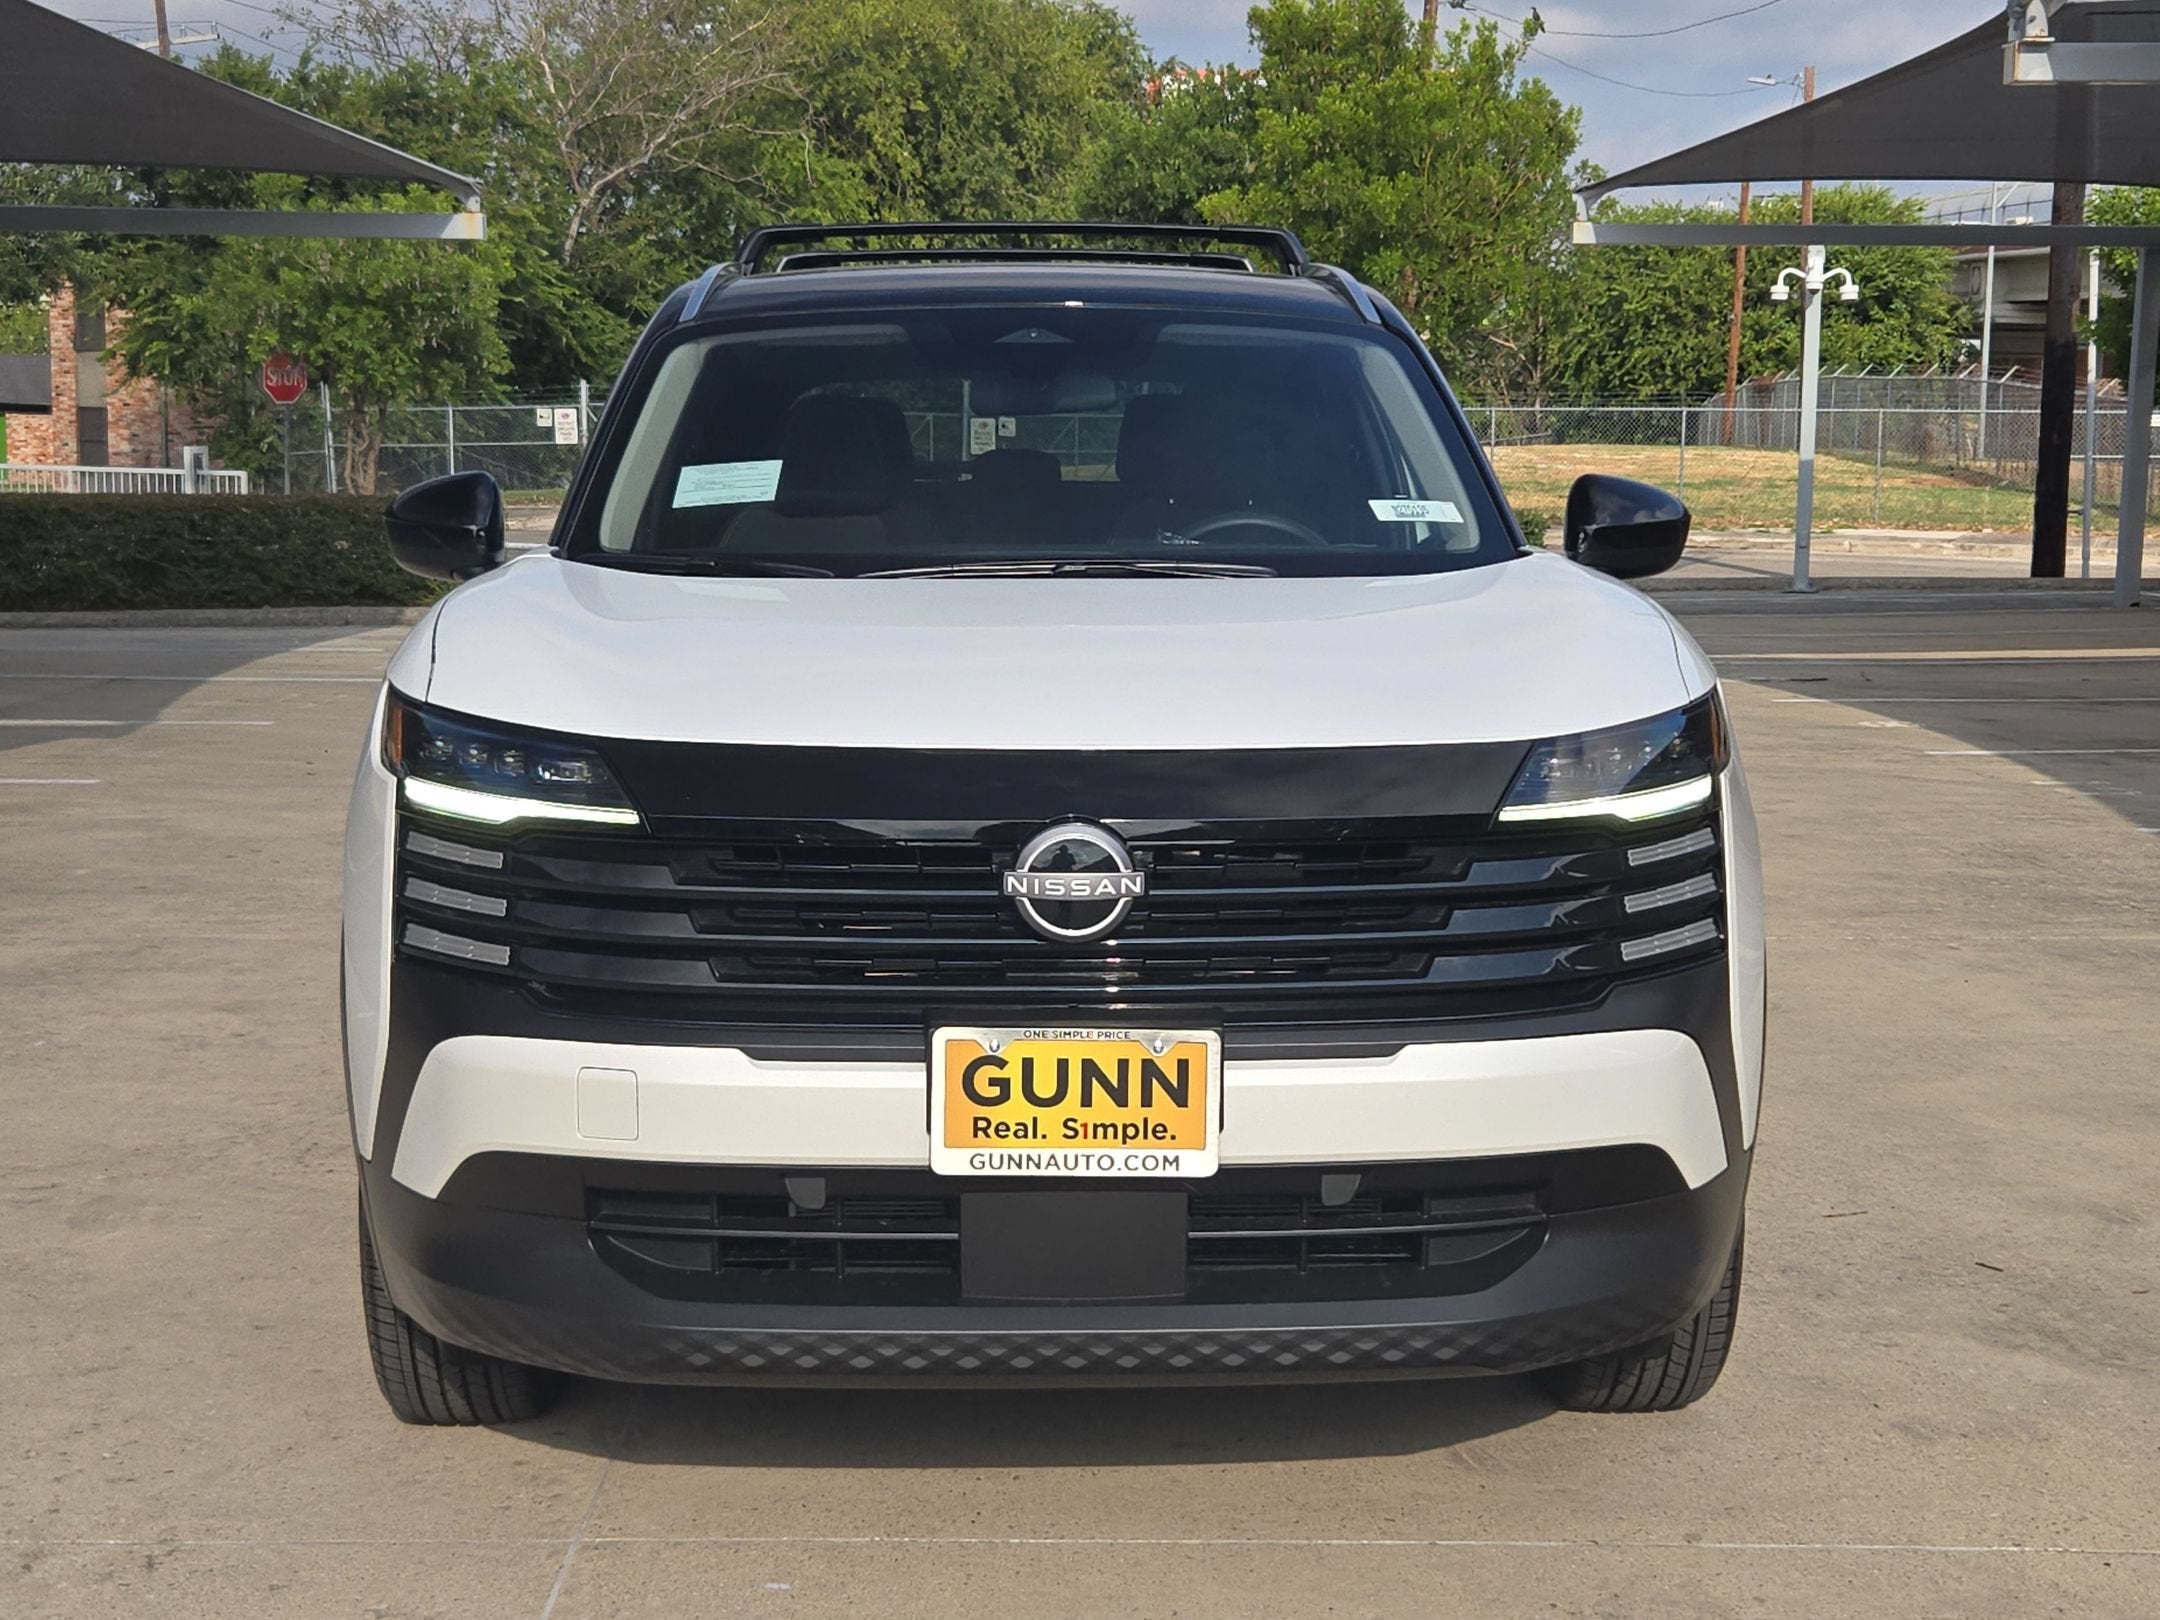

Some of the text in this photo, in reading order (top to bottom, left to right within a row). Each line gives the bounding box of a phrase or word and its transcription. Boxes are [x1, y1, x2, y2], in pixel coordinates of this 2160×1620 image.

[1007, 876, 1141, 896] NISSAN
[1023, 1029, 1131, 1039] ONE SIMPLE PRICE
[962, 1055, 1189, 1108] GUNN
[972, 1116, 1047, 1139] Real.
[969, 1153, 1180, 1171] GUNNAUTO.COM
